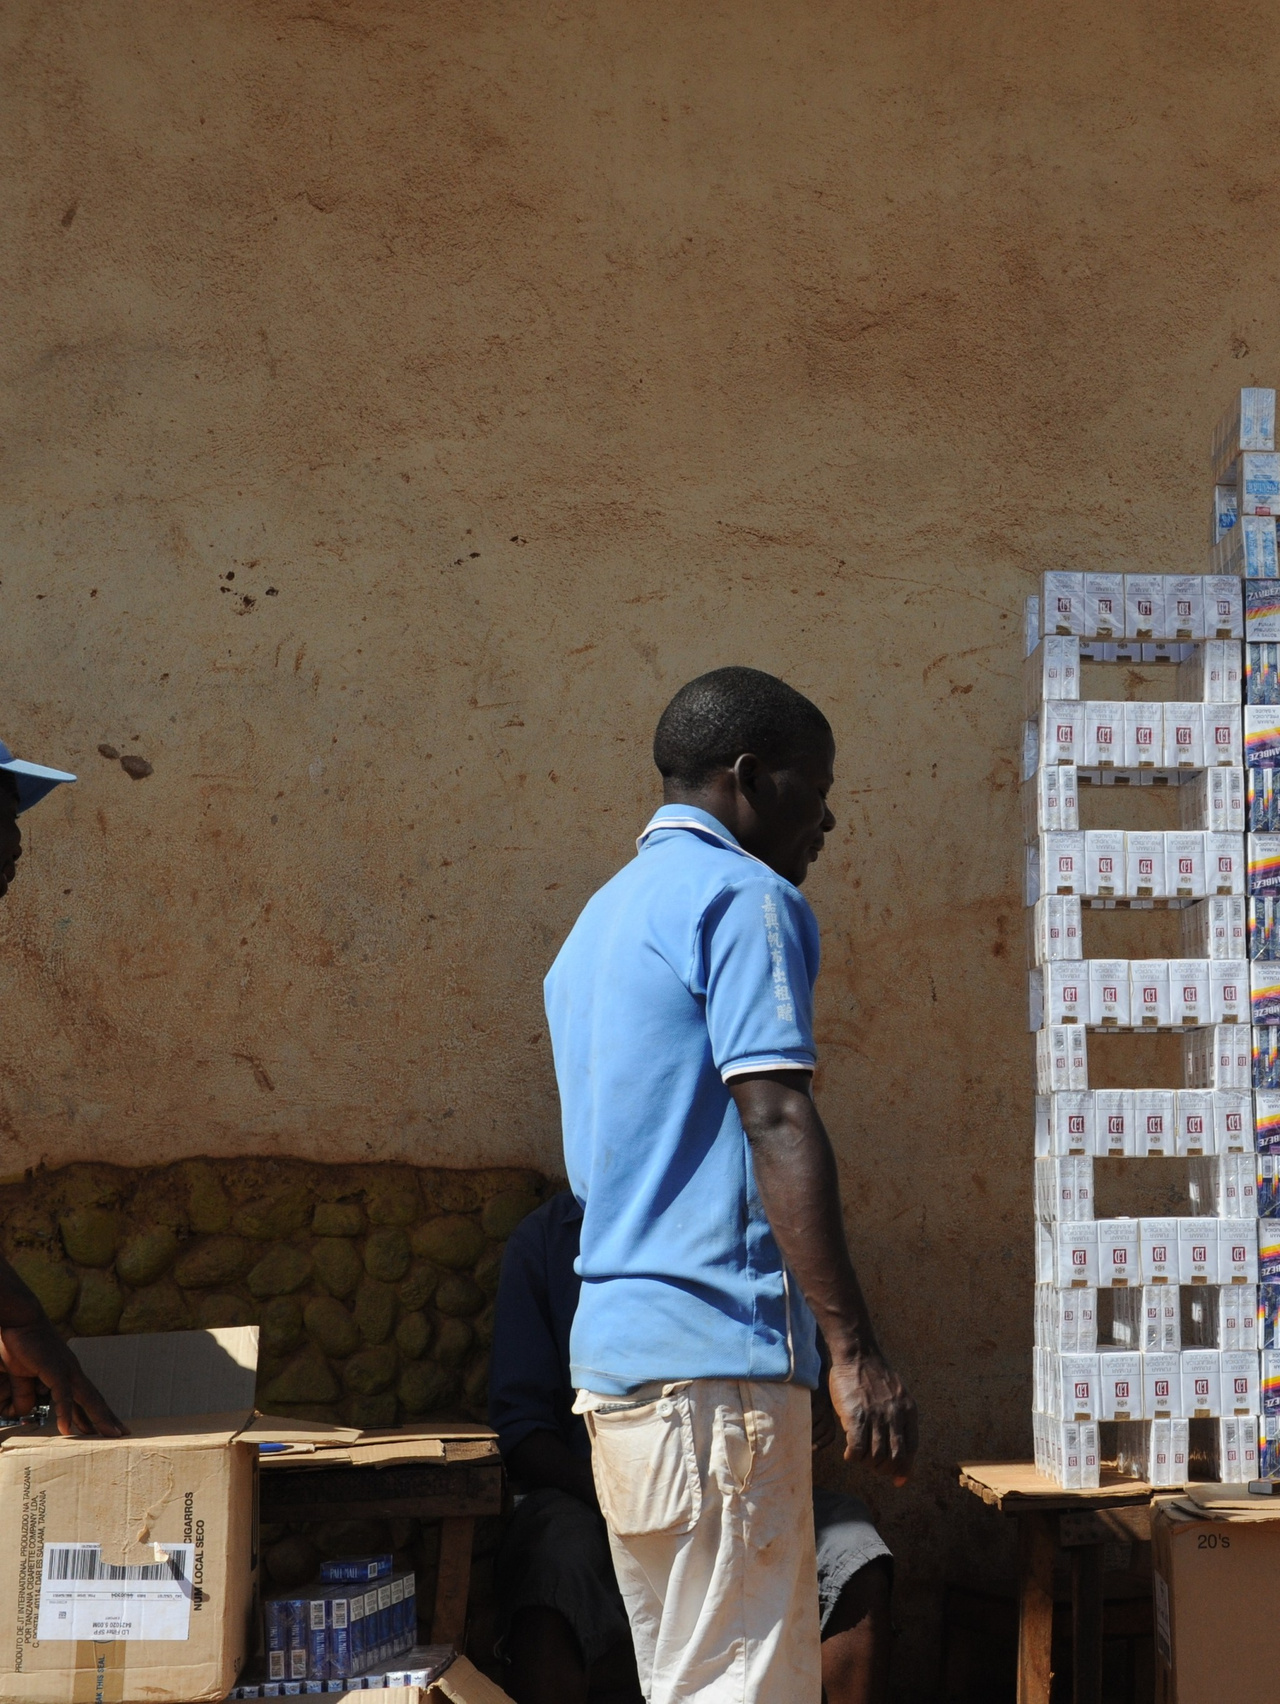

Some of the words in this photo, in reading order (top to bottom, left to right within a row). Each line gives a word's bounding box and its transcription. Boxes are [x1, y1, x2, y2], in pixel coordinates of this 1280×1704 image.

[22, 1466, 31, 1500] TANZANIA
[22, 1502, 30, 1512] NA
[38, 1490, 47, 1524] TANZANIA
[20, 1514, 30, 1556] PRODUZIDO
[28, 1513, 38, 1548] COMPANY
[196, 1520, 204, 1543] SECO
[1197, 1534, 1230, 1550] 20's
[27, 1550, 36, 1590] CIGARETTE
[35, 1571, 43, 1585] DAR
[36, 1559, 44, 1569] ES
[195, 1545, 204, 1581] LOCAL
[18, 1559, 28, 1614] INTERNATIONAL
[194, 1584, 204, 1611] NUM
[17, 1616, 25, 1624] JT
[25, 1592, 34, 1626] TANZANIA
[16, 1626, 24, 1636] DE
[15, 1638, 24, 1673] PRODUTO
[96, 1675, 104, 1690] THIS
